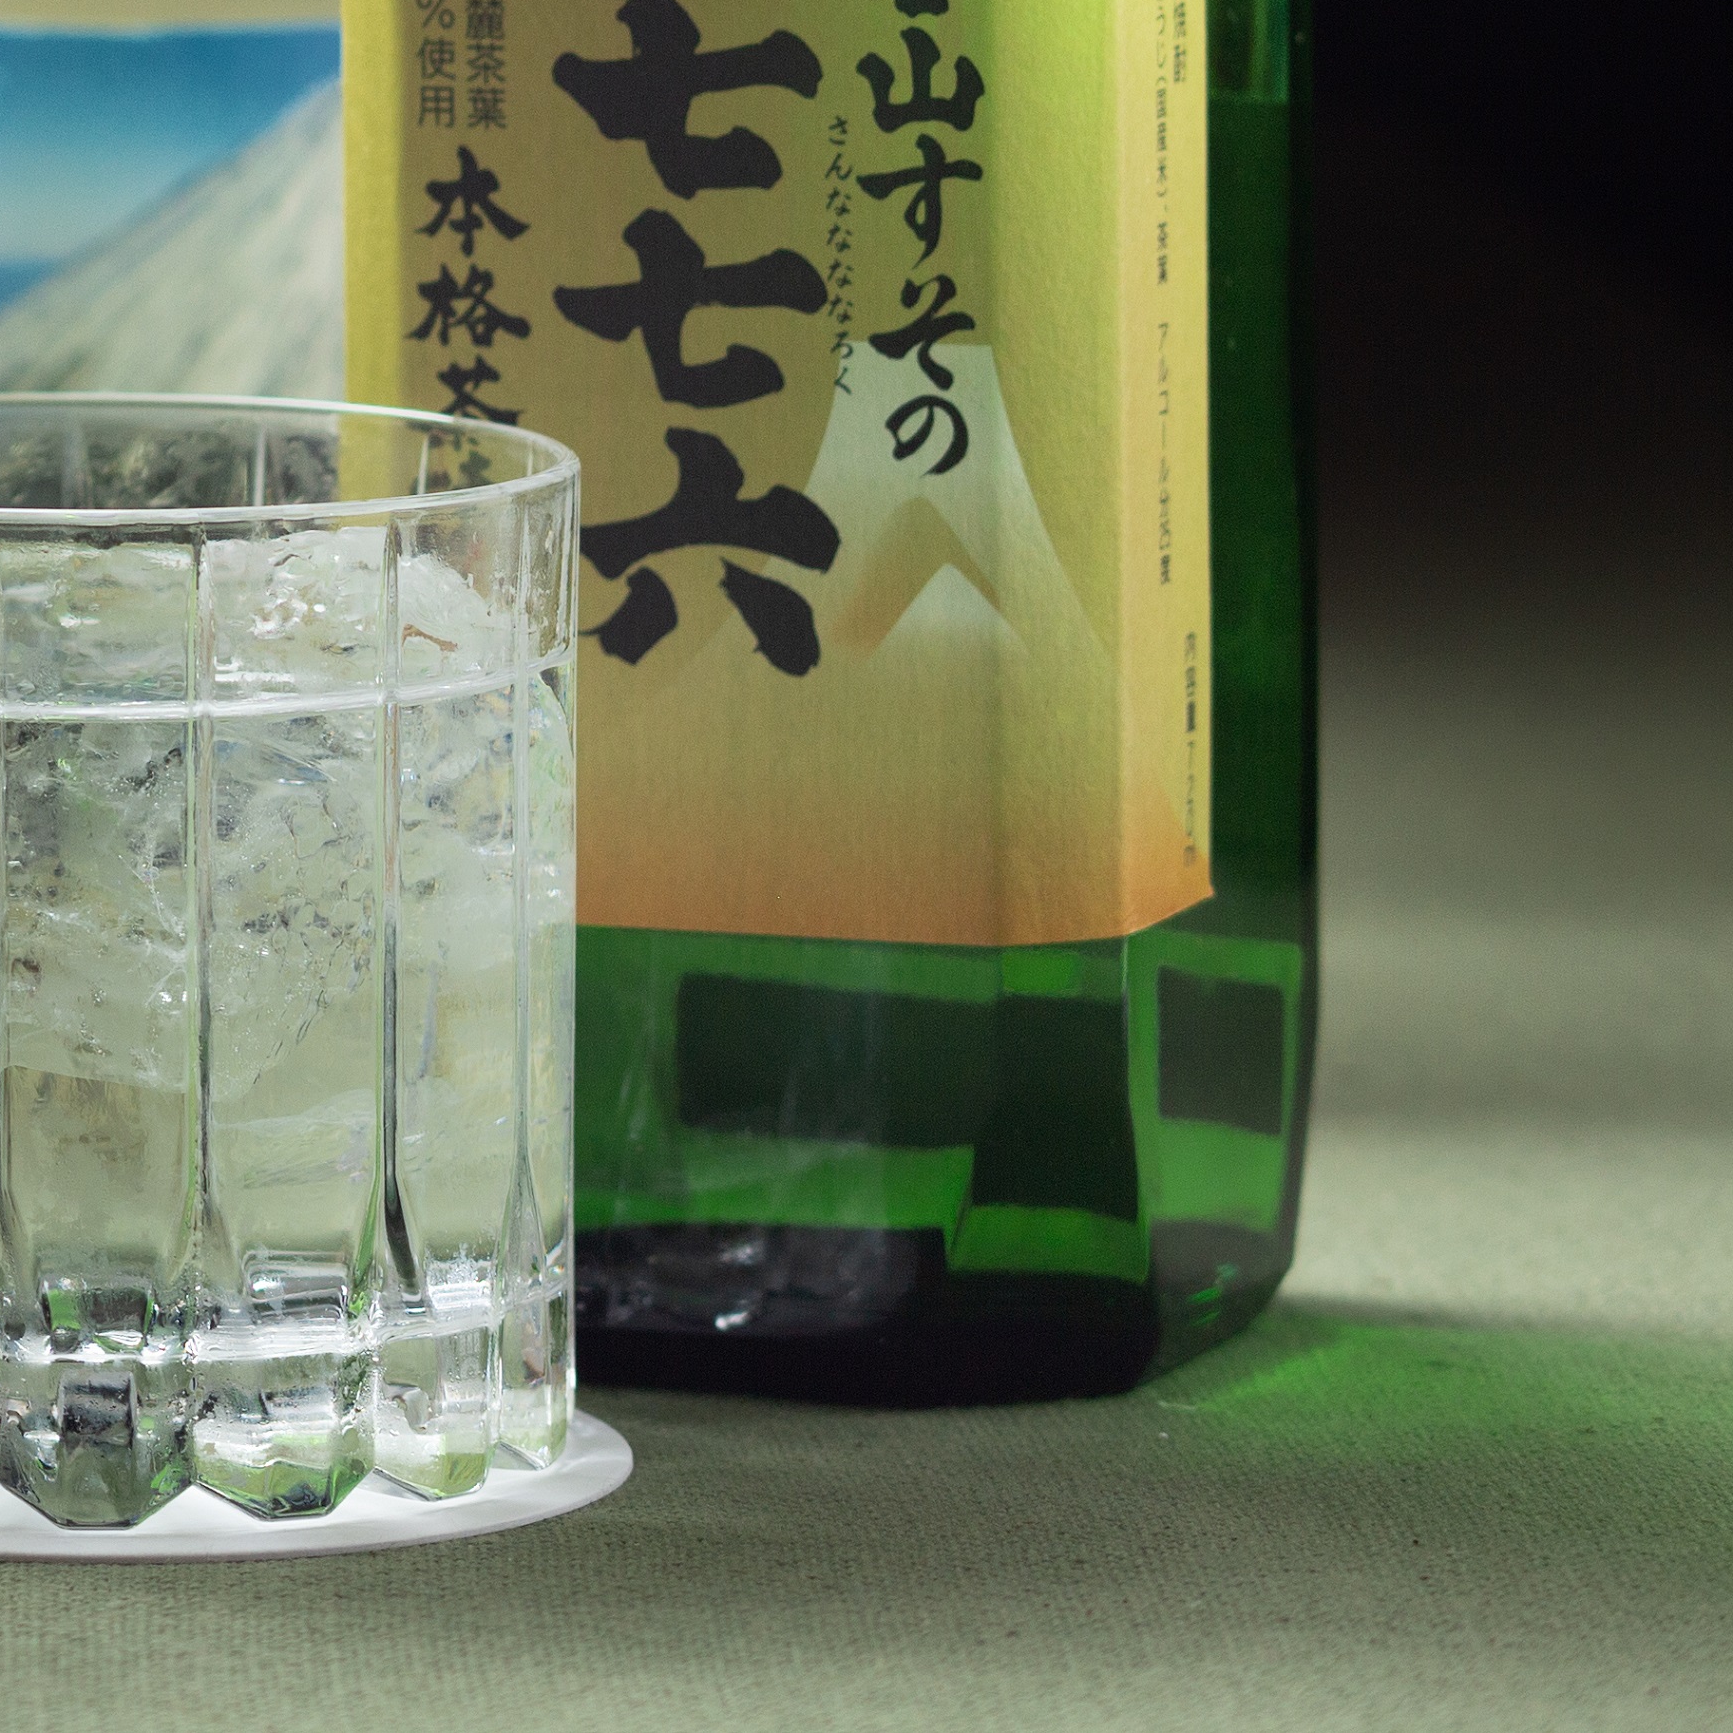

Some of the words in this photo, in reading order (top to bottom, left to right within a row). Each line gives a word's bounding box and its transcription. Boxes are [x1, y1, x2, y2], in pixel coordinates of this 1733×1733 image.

[824, 112, 854, 398] さんななななろく
